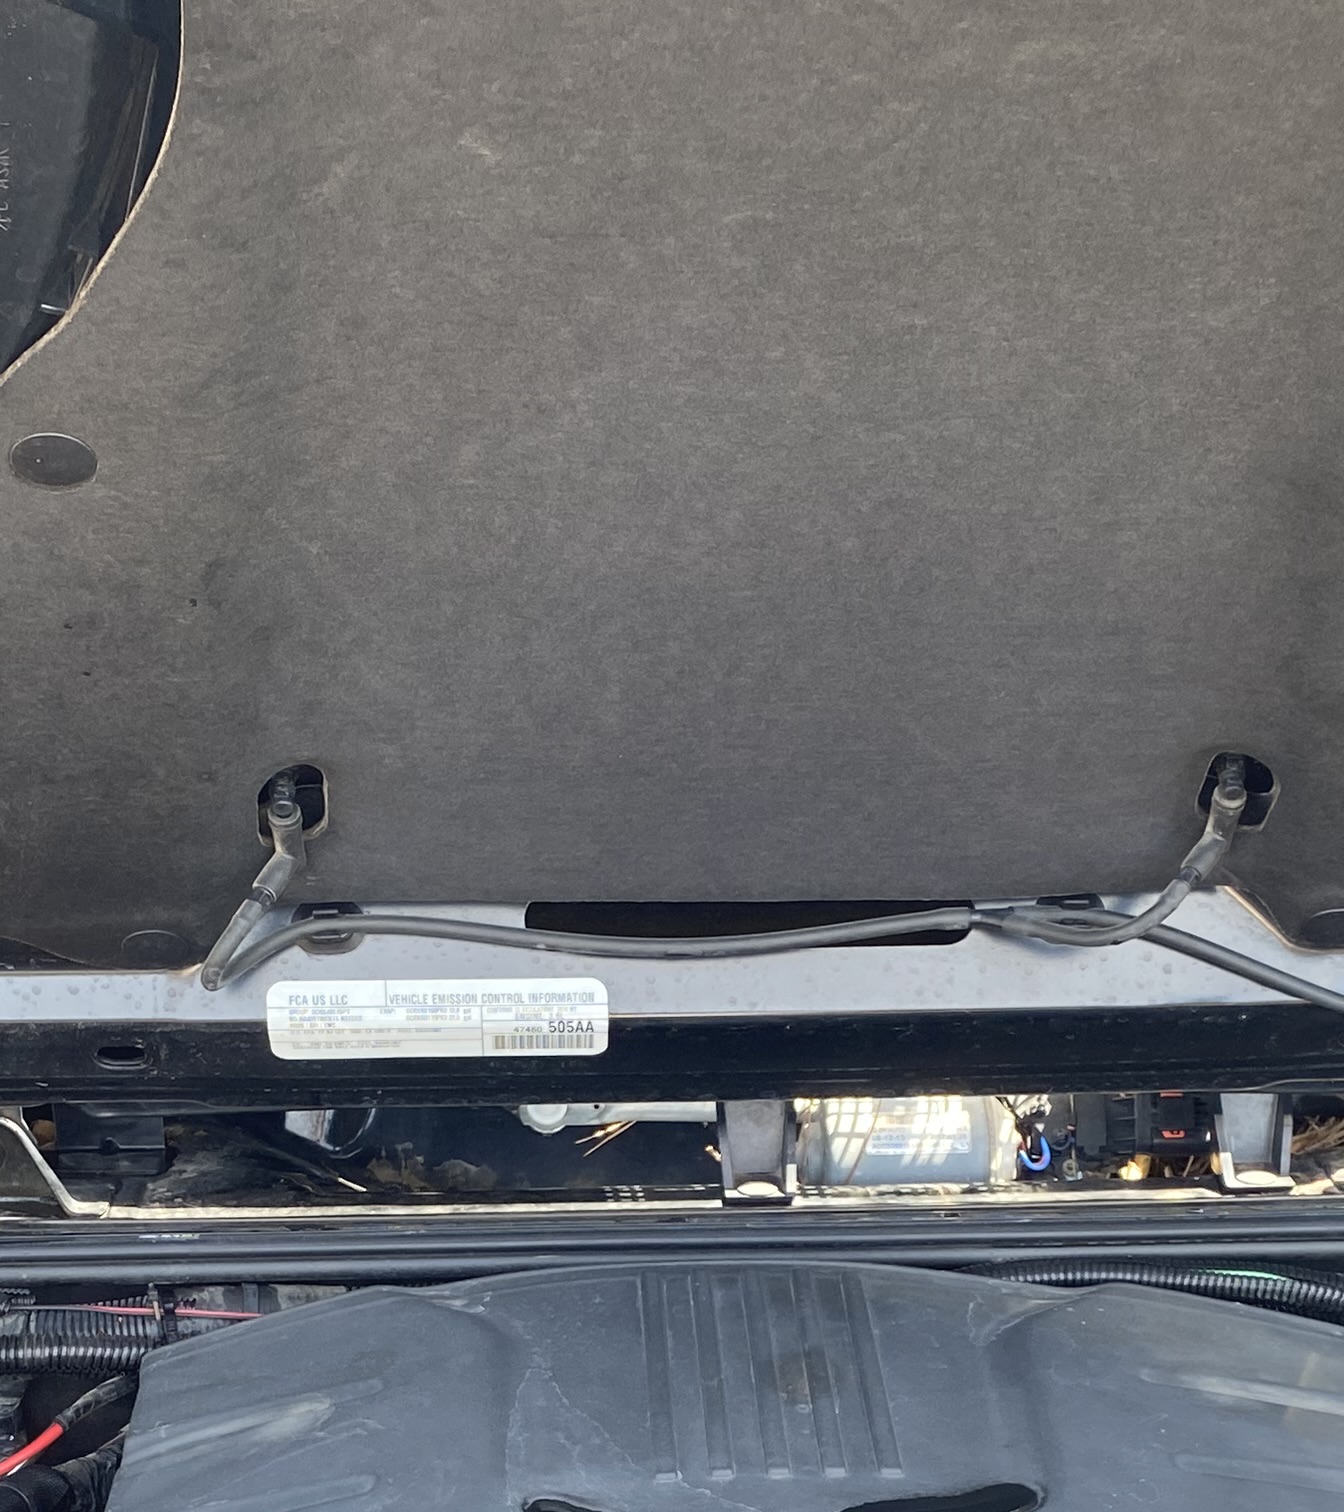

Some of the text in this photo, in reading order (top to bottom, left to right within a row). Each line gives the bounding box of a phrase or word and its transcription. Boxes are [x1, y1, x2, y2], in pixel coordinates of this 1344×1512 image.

[288, 993, 349, 1007] FCA US LLC
[388, 990, 595, 1006] VEHICLE EMISSION CONTROL INFORMATION
[548, 1020, 595, 1035] 505AA
